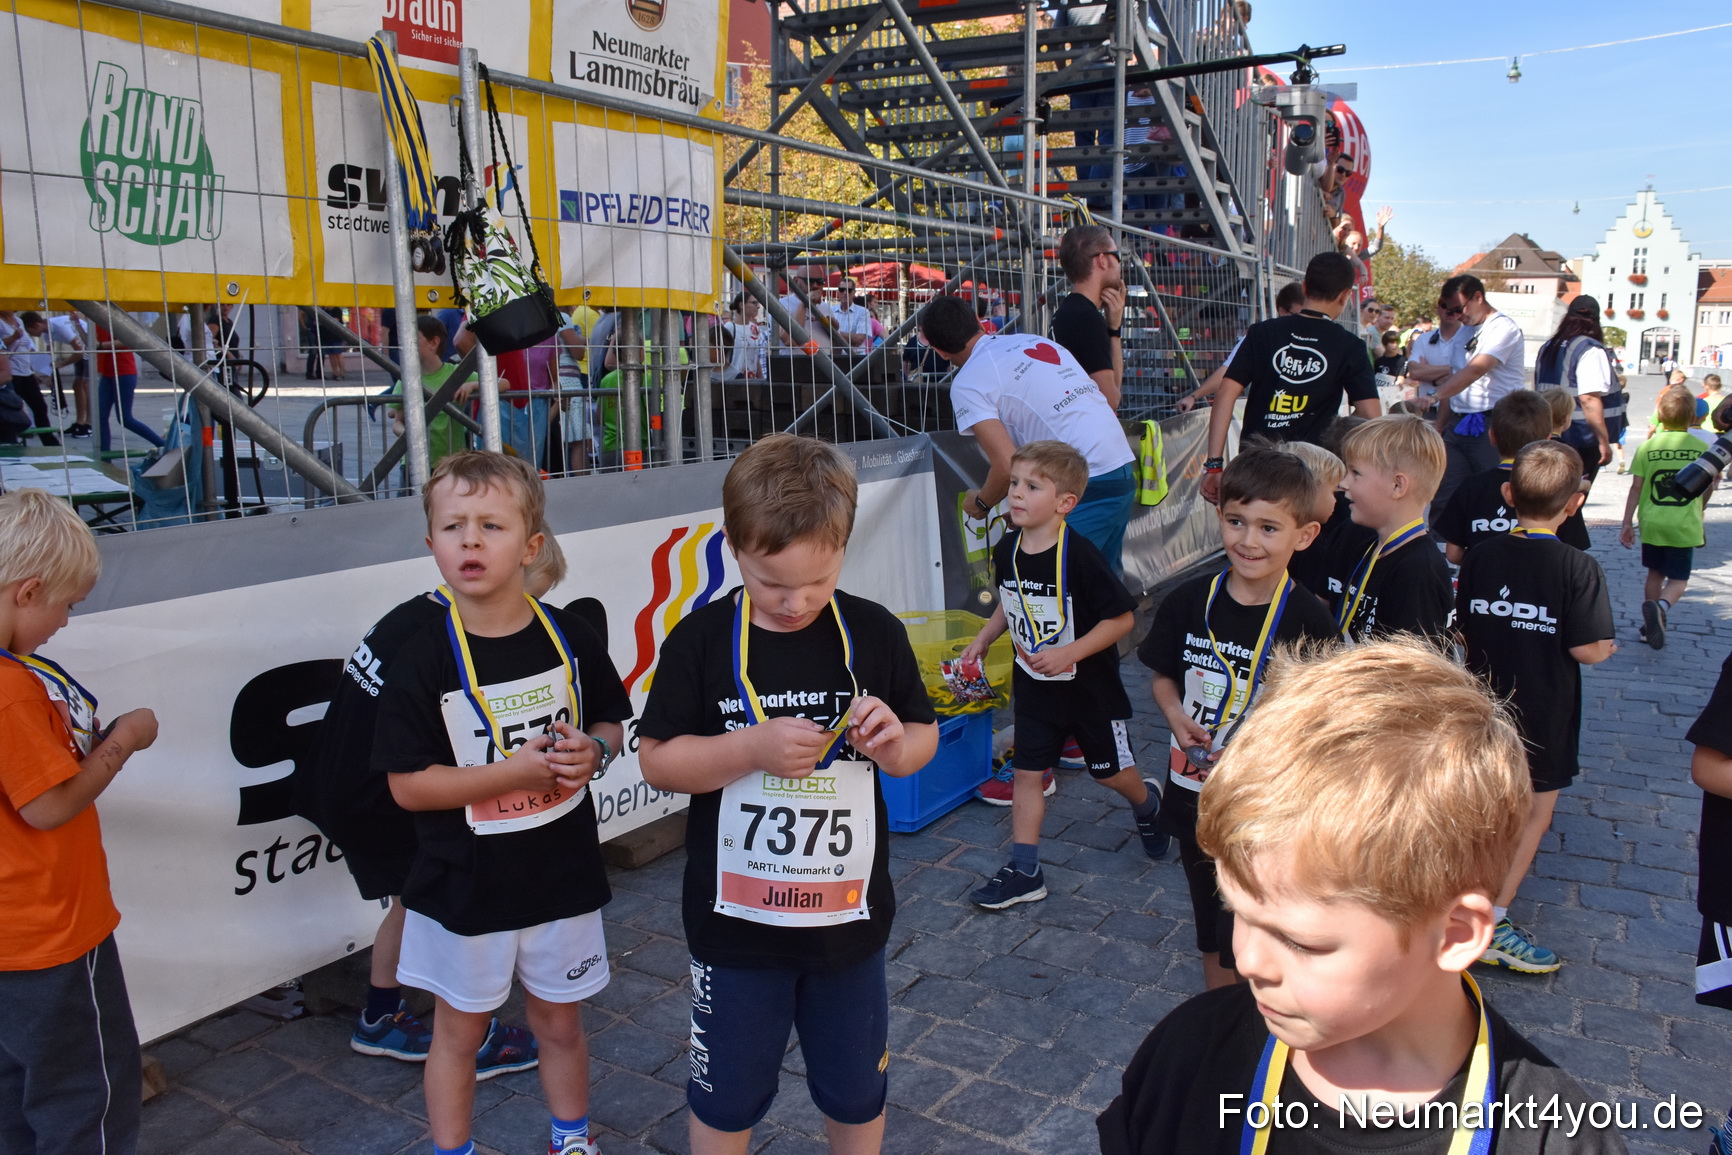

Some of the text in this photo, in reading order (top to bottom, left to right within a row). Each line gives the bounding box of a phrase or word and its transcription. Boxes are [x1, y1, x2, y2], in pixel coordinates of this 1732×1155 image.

[637, 12, 655, 25] 1628
[411, 29, 463, 49] Sicher ist sicher
[592, 30, 690, 71] Neumarkter
[569, 50, 700, 106] Lammsbräu
[87, 60, 206, 167] RUND
[89, 160, 225, 242] SCHAU
[585, 192, 710, 234] PFLEIDERER
[1013, 361, 1025, 373] Haus
[1021, 361, 1034, 376] Marien
[1053, 390, 1077, 412] Praxis
[862, 453, 893, 469] Mobilität
[1647, 449, 1702, 462] BOCK
[487, 684, 555, 714] BOCK
[494, 711, 512, 720] nspired
[520, 706, 536, 715] smart
[536, 699, 556, 711] concepts
[1091, 762, 1111, 770] JAKO
[762, 773, 837, 794] BOCK
[497, 788, 562, 813] Lukas
[762, 790, 785, 798] inspired
[786, 792, 794, 800] by
[740, 802, 853, 857] 7375
[724, 837, 734, 848] B2
[747, 860, 831, 875] PARTL Neumarkt
[762, 886, 823, 908] Julian
[573, 956, 602, 974] TOUCH
[580, 954, 598, 967] PRO
